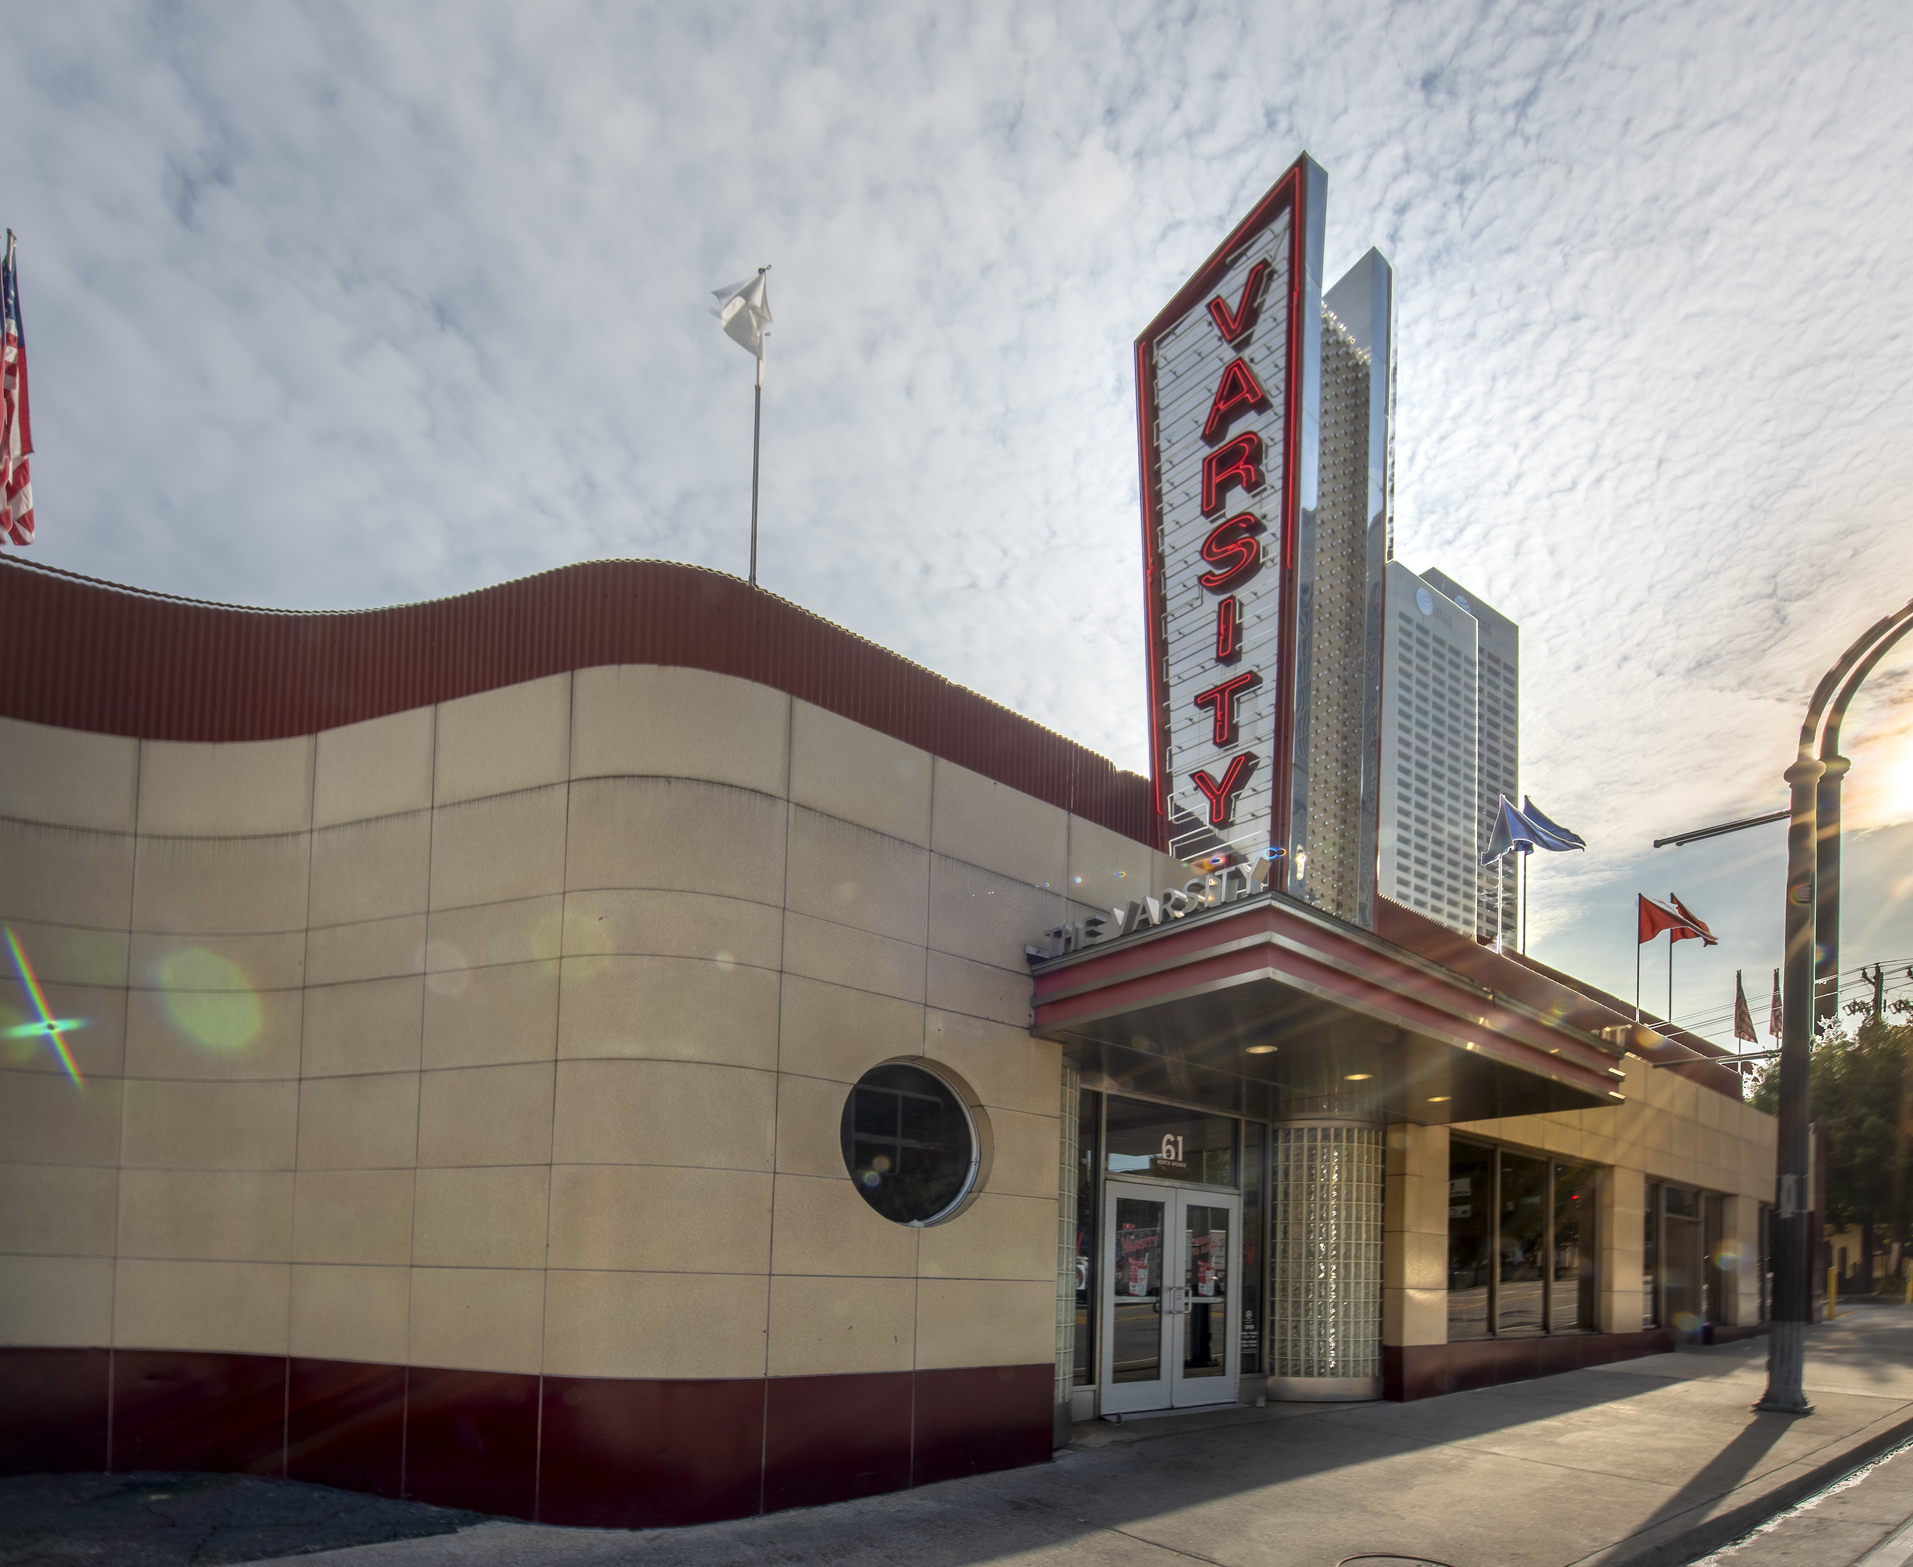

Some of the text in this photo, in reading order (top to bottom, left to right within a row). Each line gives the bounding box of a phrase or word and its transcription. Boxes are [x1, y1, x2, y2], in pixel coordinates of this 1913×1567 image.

[1189, 258, 1276, 830] VARSITY
[1045, 857, 1272, 958] THE VARSITY
[1161, 1133, 1184, 1162] 61
